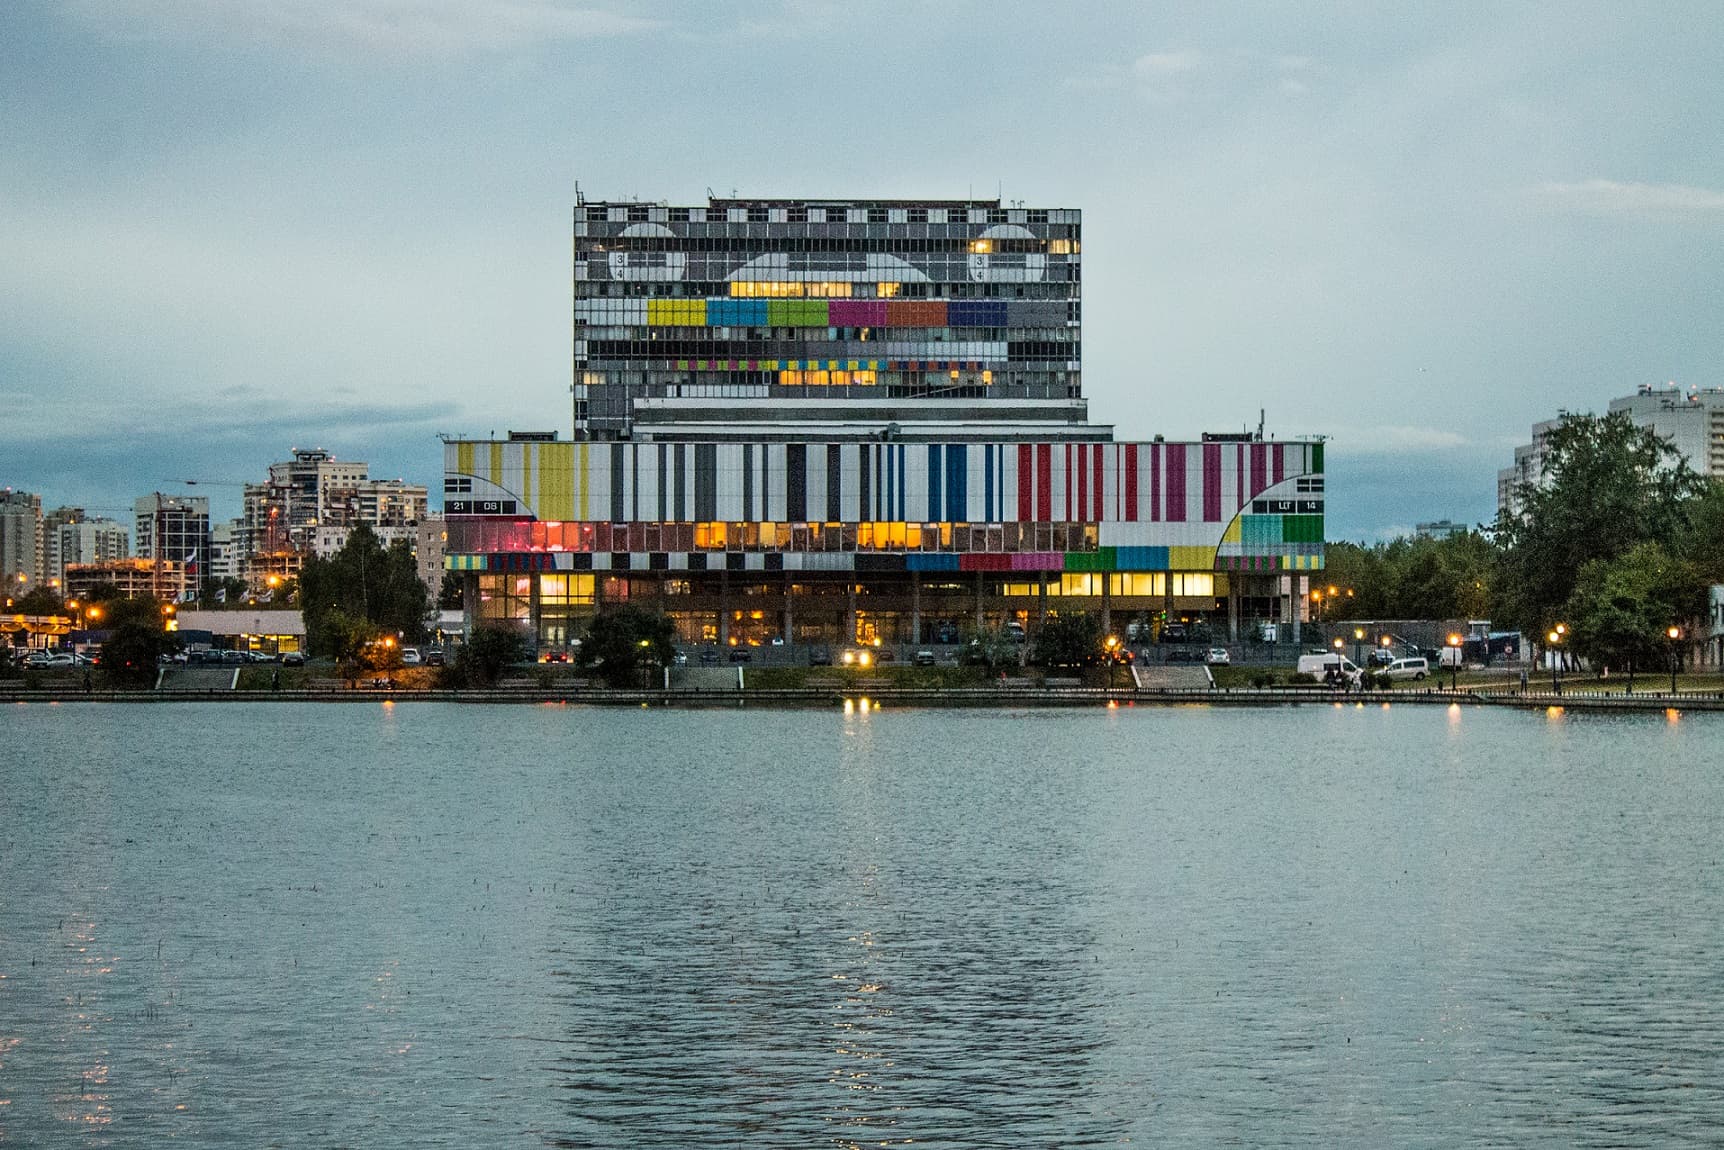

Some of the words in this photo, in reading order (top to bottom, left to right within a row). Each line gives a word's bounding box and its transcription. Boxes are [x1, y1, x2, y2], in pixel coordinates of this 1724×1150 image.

[617, 255, 623, 264] 3
[976, 256, 983, 265] 3
[617, 269, 623, 279] 4
[976, 271, 983, 280] 4
[453, 501, 464, 510] 21
